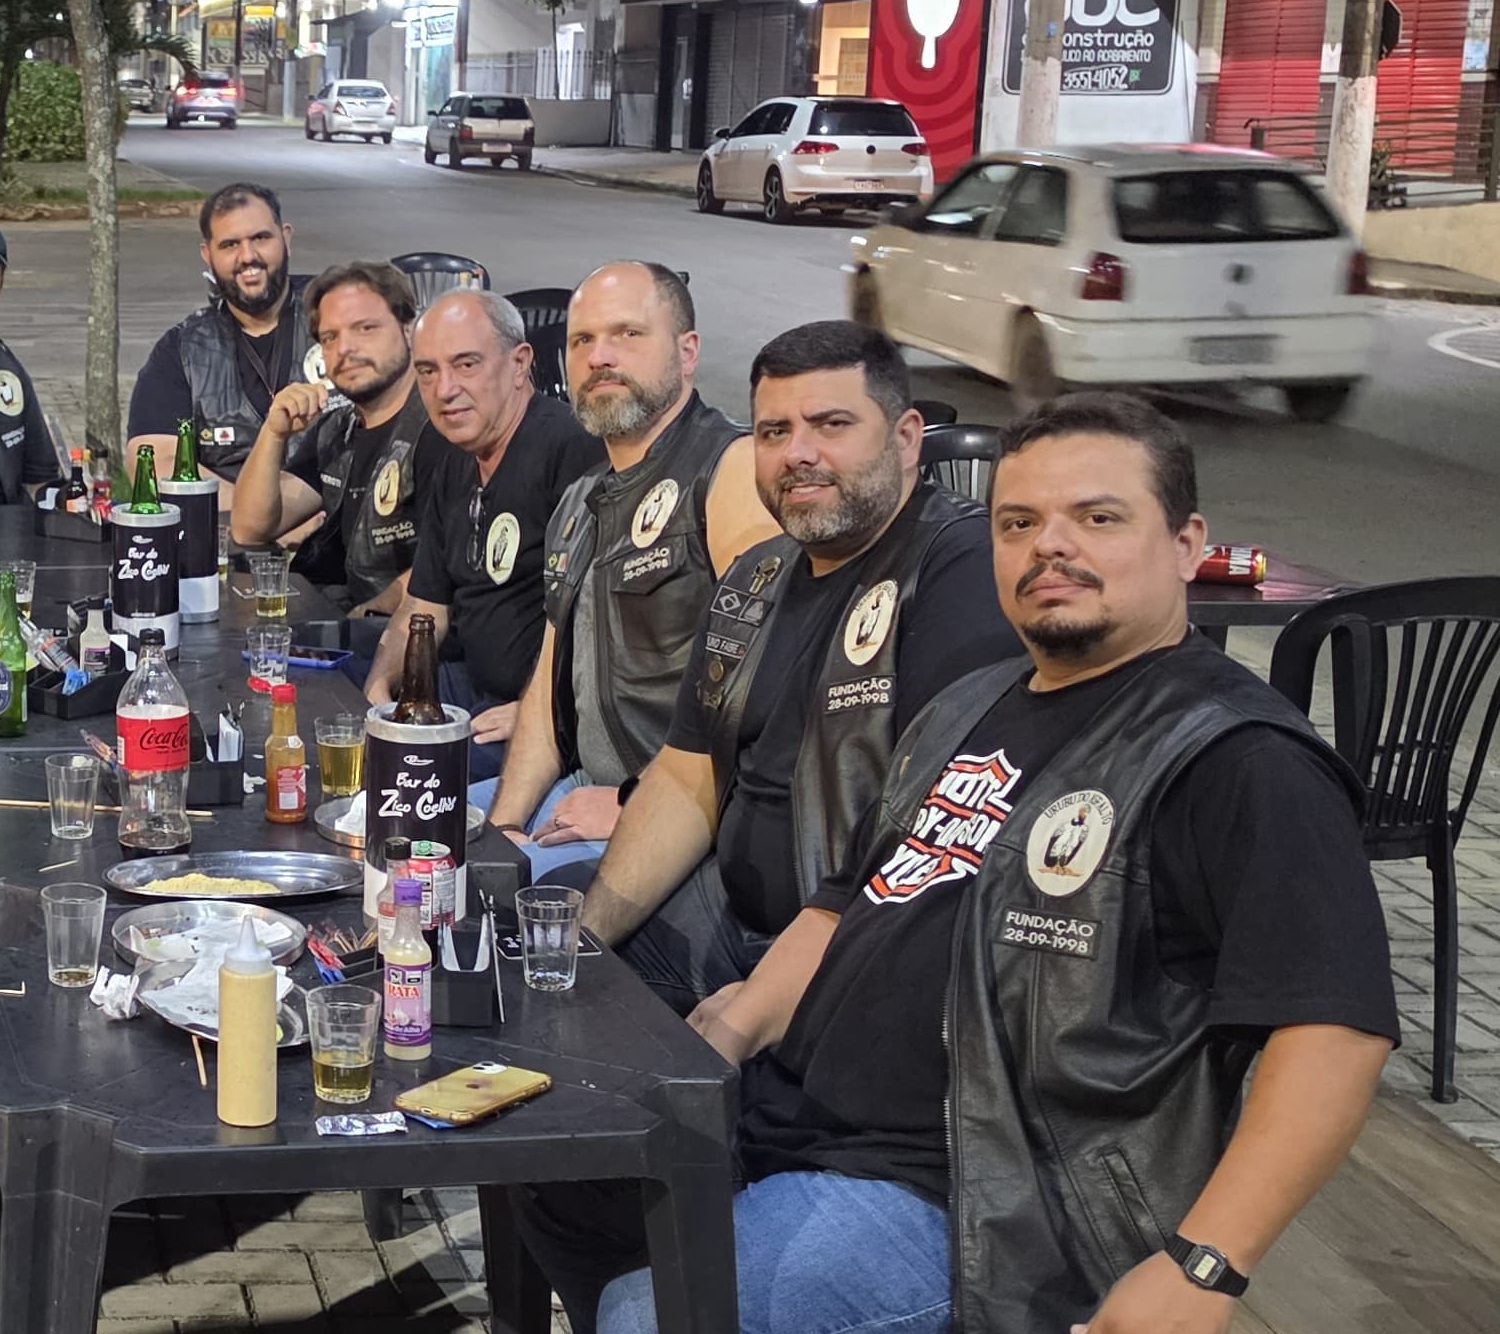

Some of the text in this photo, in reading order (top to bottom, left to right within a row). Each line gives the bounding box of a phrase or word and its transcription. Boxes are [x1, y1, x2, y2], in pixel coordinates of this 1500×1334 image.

[1061, 29, 1155, 48] onstrução
[828, 678, 891, 698] FUNDAÇÃO
[827, 693, 889, 710] 28-09-1998
[396, 772, 440, 789] Bar do
[378, 789, 411, 817] Zico
[1043, 795, 1077, 819] URUBU
[1005, 910, 1094, 938] FUNDAÇÃO
[1003, 927, 1089, 955] 28-09-1998
